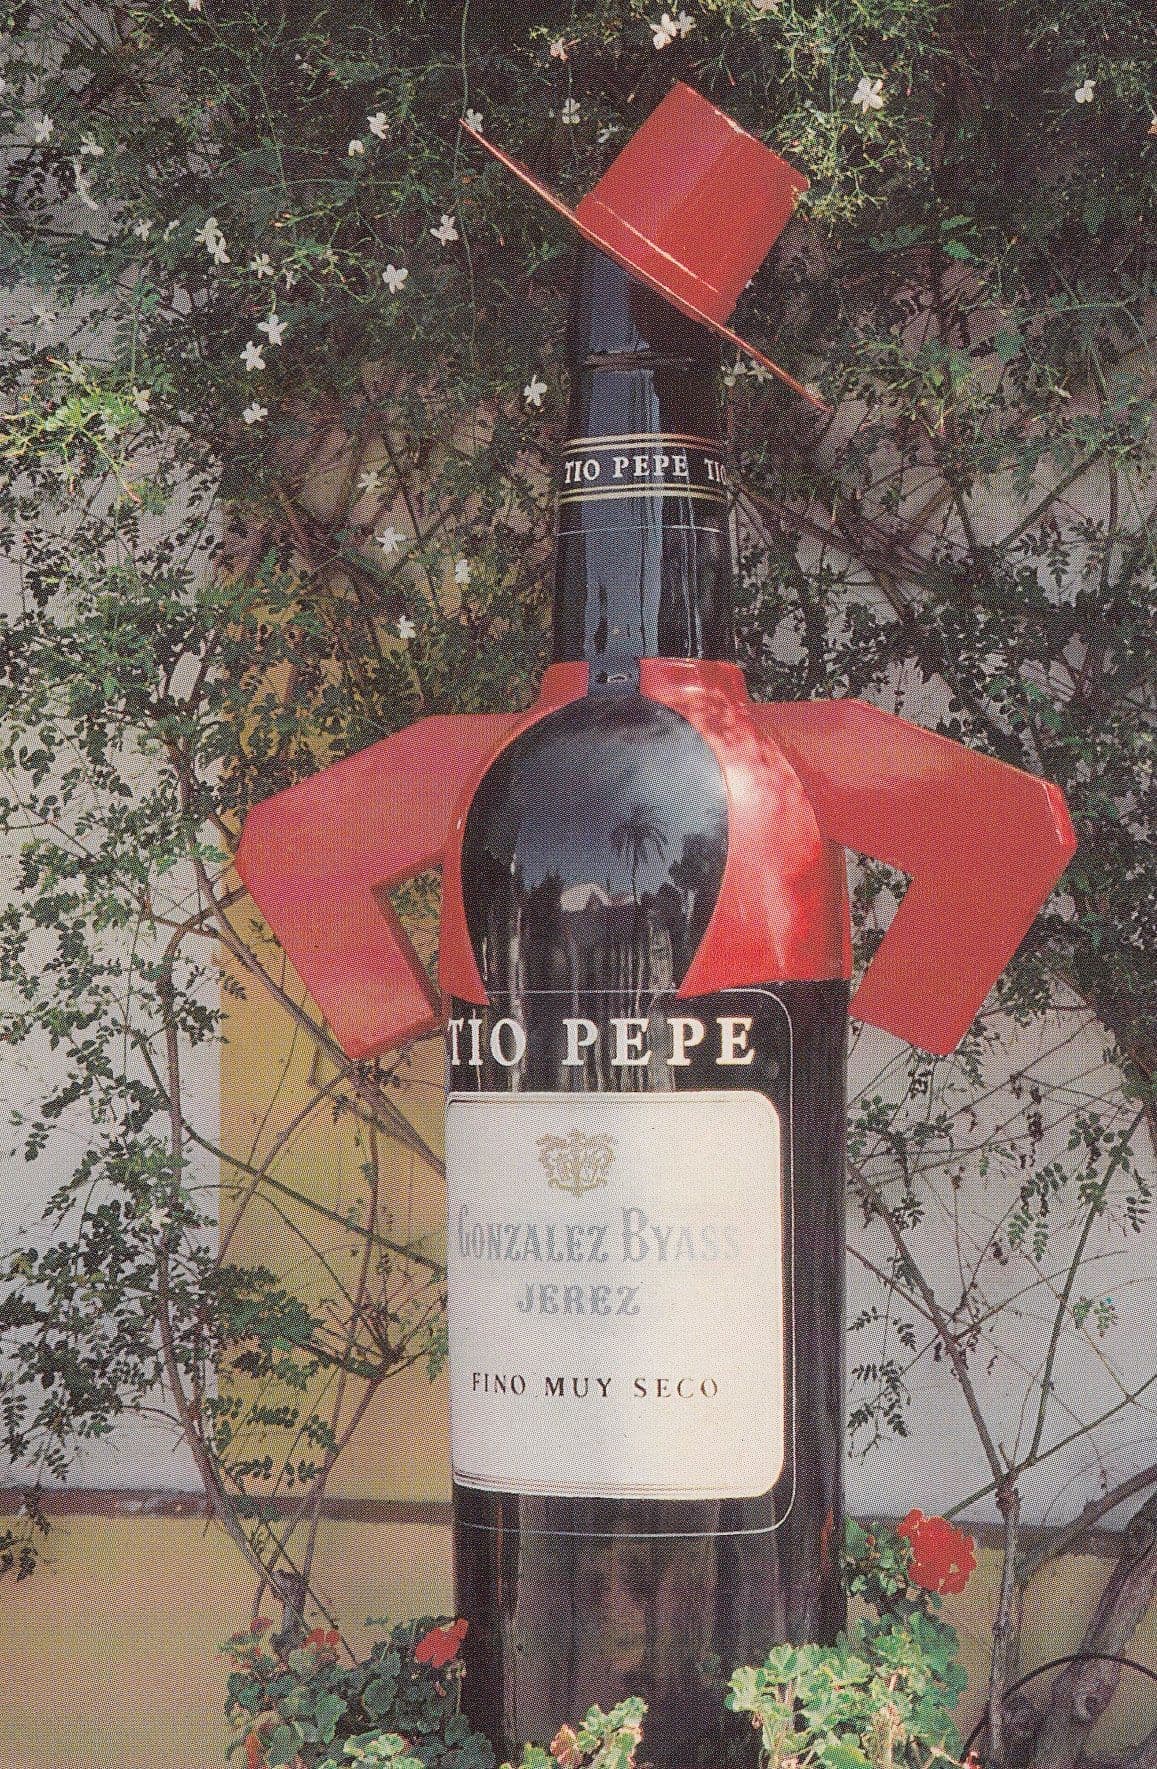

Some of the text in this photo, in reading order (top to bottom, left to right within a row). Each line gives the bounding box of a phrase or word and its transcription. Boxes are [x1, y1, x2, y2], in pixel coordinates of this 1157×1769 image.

[565, 459, 600, 484] TIO
[613, 454, 690, 478] PEPE
[448, 1017, 755, 1067] TIO PEPE
[516, 1283, 641, 1316] JEREZ
[472, 1372, 719, 1399] FINO MUY SECO
